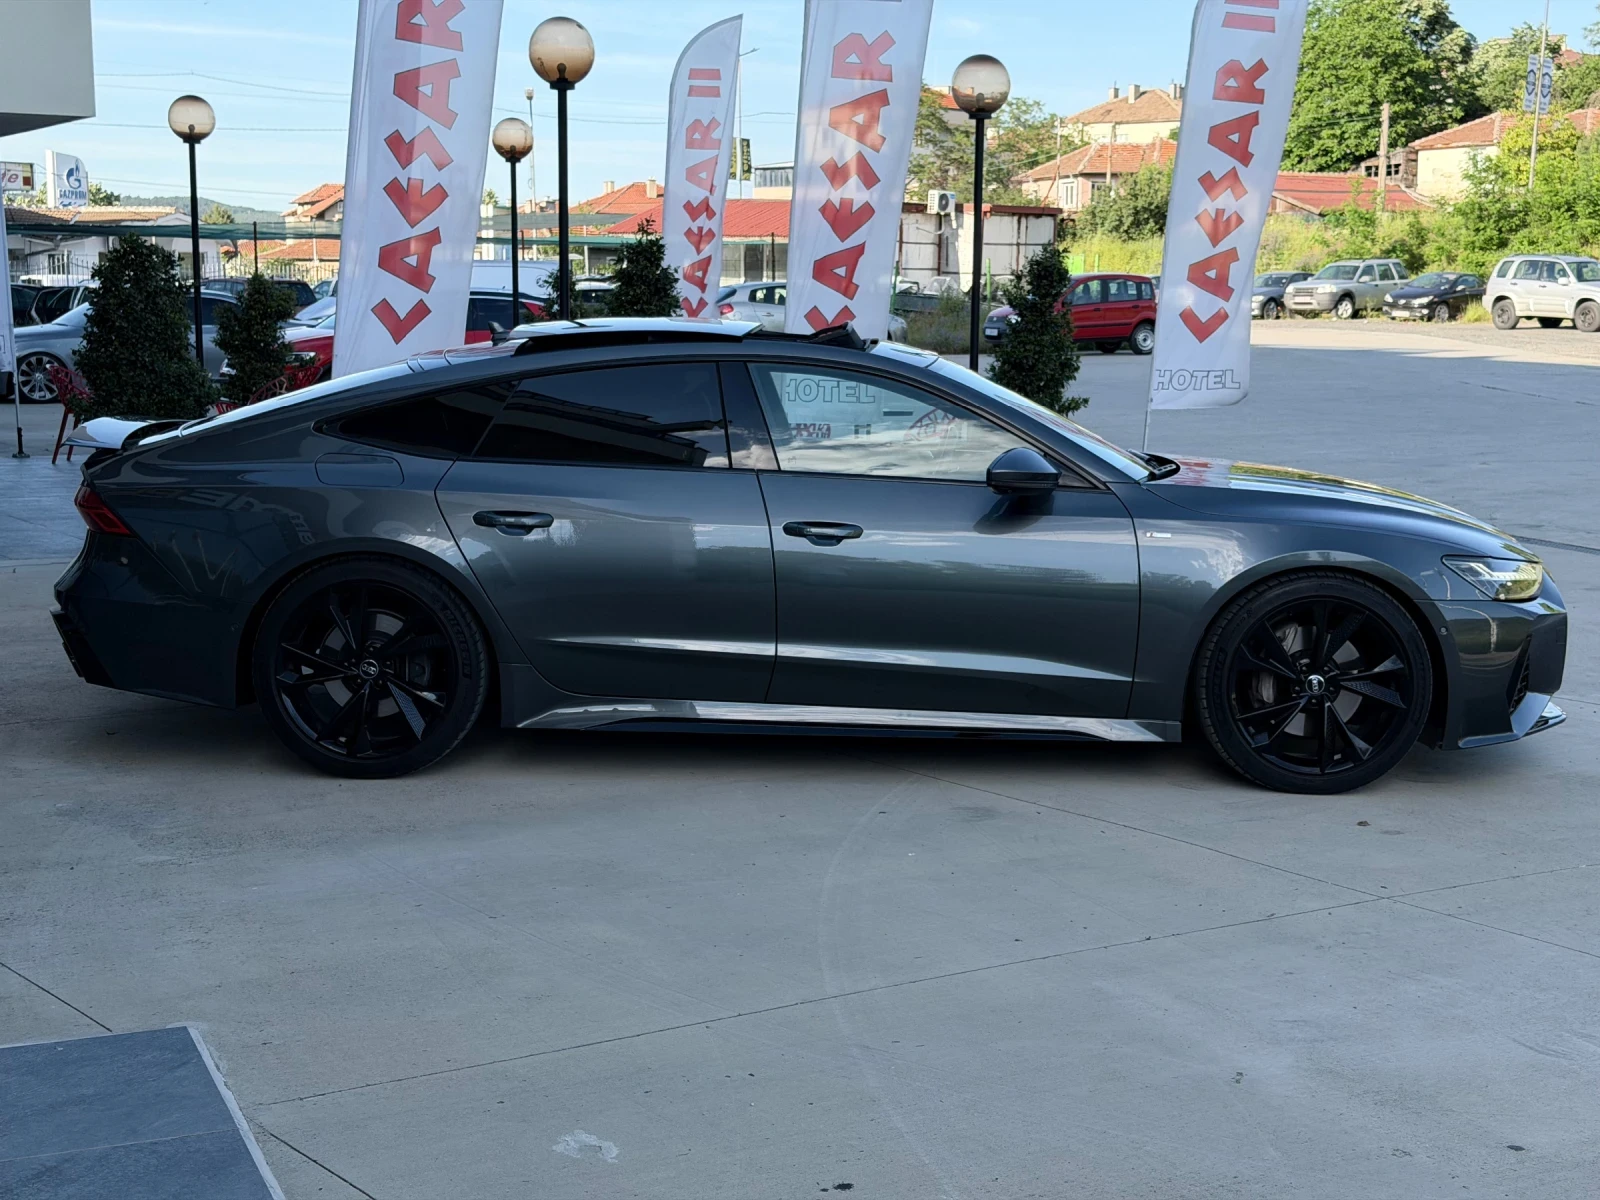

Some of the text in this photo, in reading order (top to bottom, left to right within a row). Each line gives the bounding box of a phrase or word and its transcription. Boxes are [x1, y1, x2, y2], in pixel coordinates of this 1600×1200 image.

[688, 68, 721, 97] II
[371, 0, 465, 345] CAESAR
[1179, 58, 1269, 343] CAESAR
[785, 378, 875, 403] HOTEL
[1154, 369, 1241, 391] HOTEL
